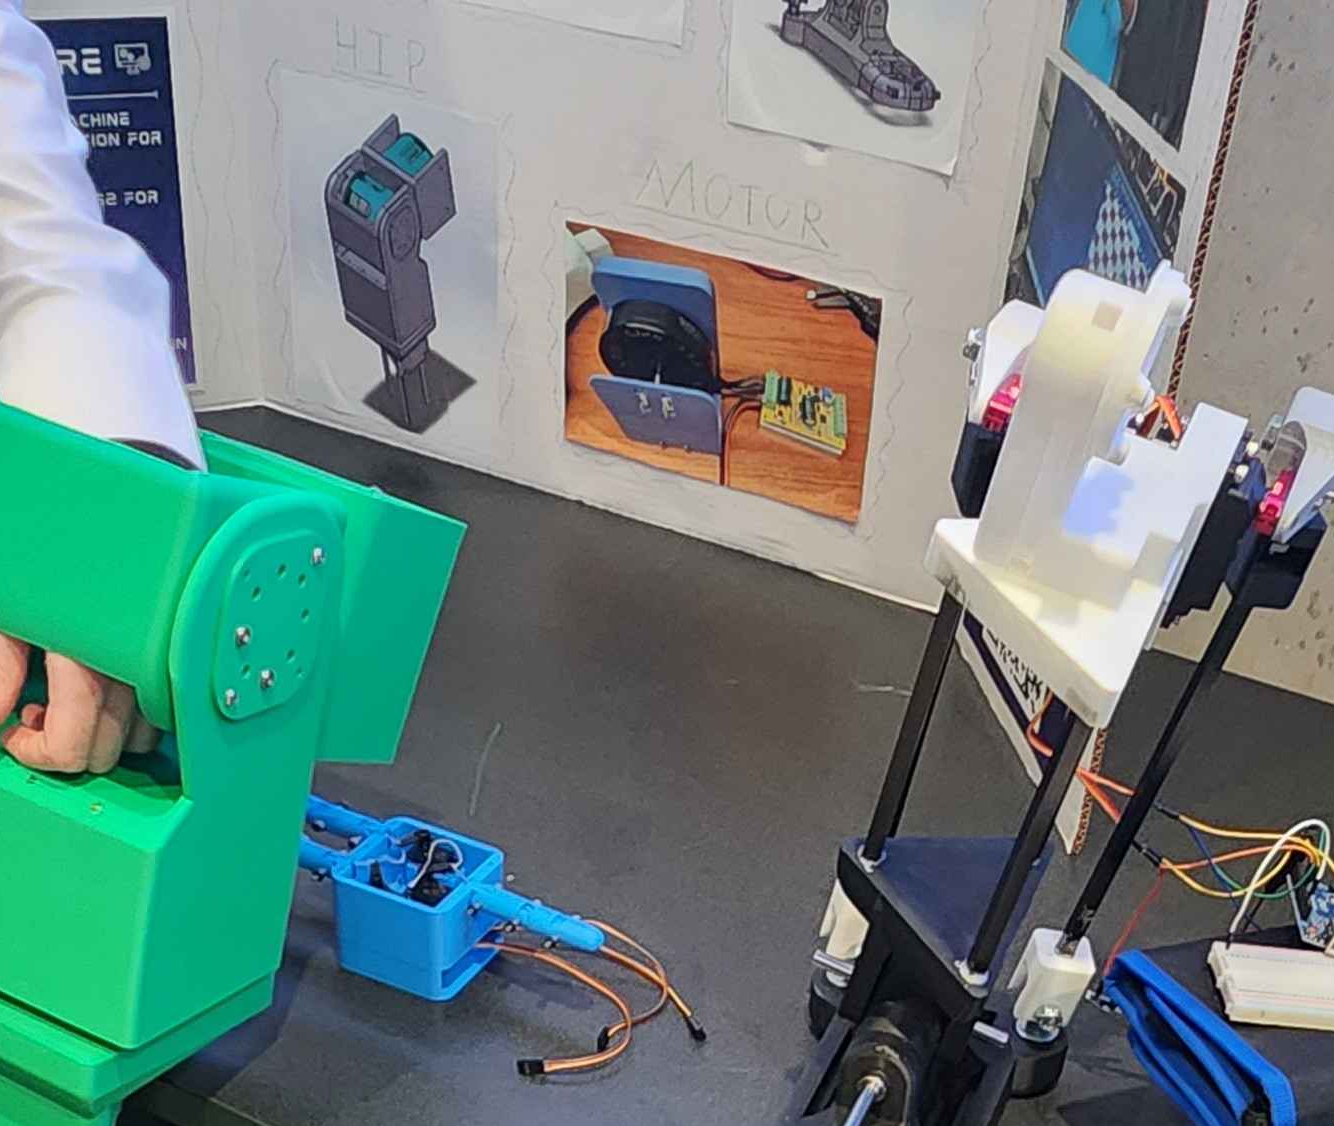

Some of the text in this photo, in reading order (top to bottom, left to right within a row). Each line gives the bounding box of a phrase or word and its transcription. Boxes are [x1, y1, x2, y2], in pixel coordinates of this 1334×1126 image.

[334, 15, 428, 86] HIP
[127, 130, 163, 147] FOR
[123, 189, 159, 206] FOR
[635, 159, 831, 249] MOTOR
